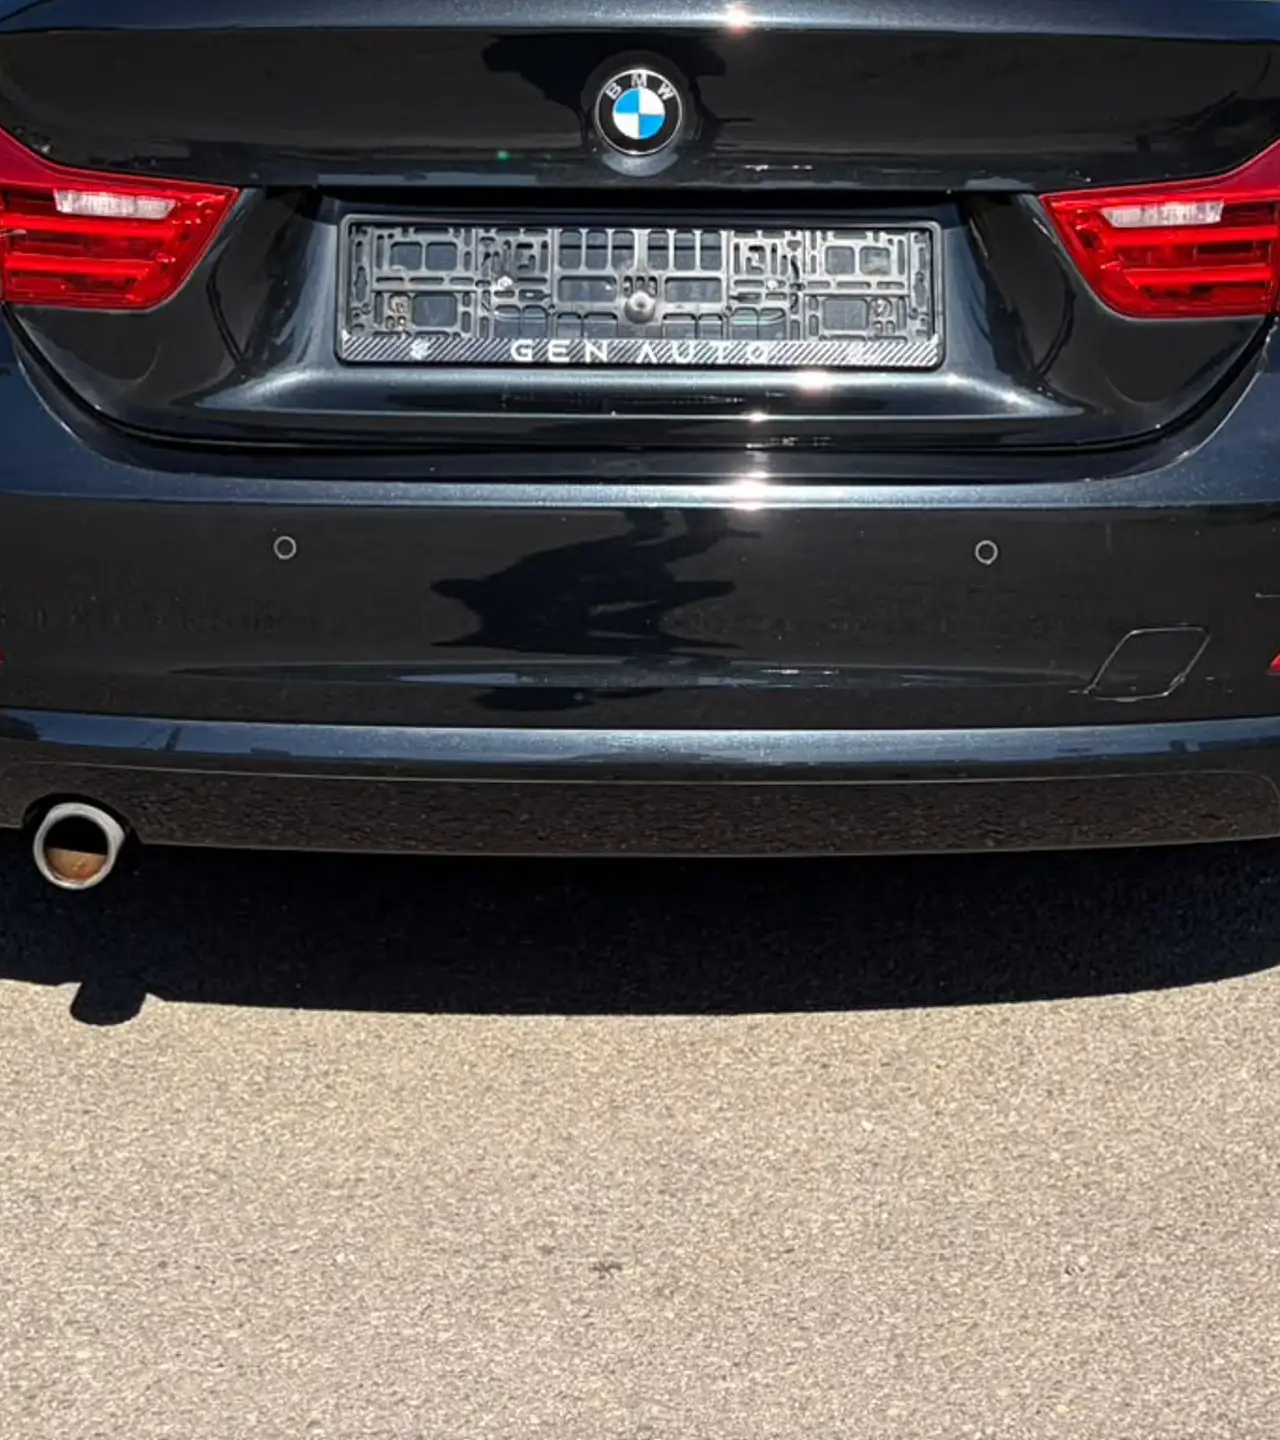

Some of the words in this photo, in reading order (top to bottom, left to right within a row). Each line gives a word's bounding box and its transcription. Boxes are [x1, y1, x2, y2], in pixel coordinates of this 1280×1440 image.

[605, 73, 675, 100] BMW
[510, 340, 608, 363] GEN
[635, 340, 770, 364] AUTO
